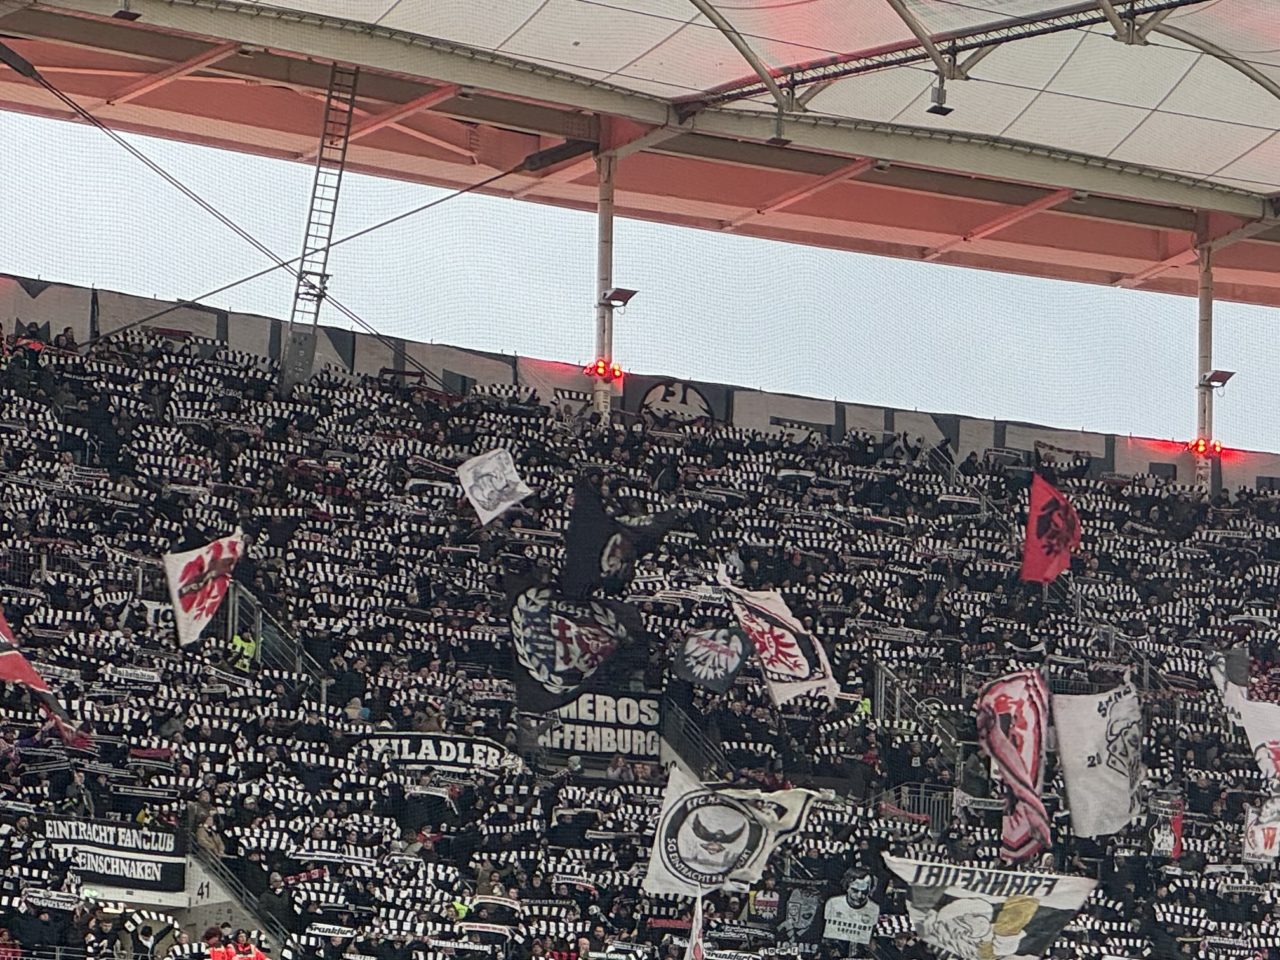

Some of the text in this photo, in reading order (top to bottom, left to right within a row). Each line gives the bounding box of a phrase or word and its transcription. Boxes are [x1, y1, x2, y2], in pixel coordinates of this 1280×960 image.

[46, 819, 176, 853] EINTRACHT FANCLUB
[197, 881, 211, 900] 41
